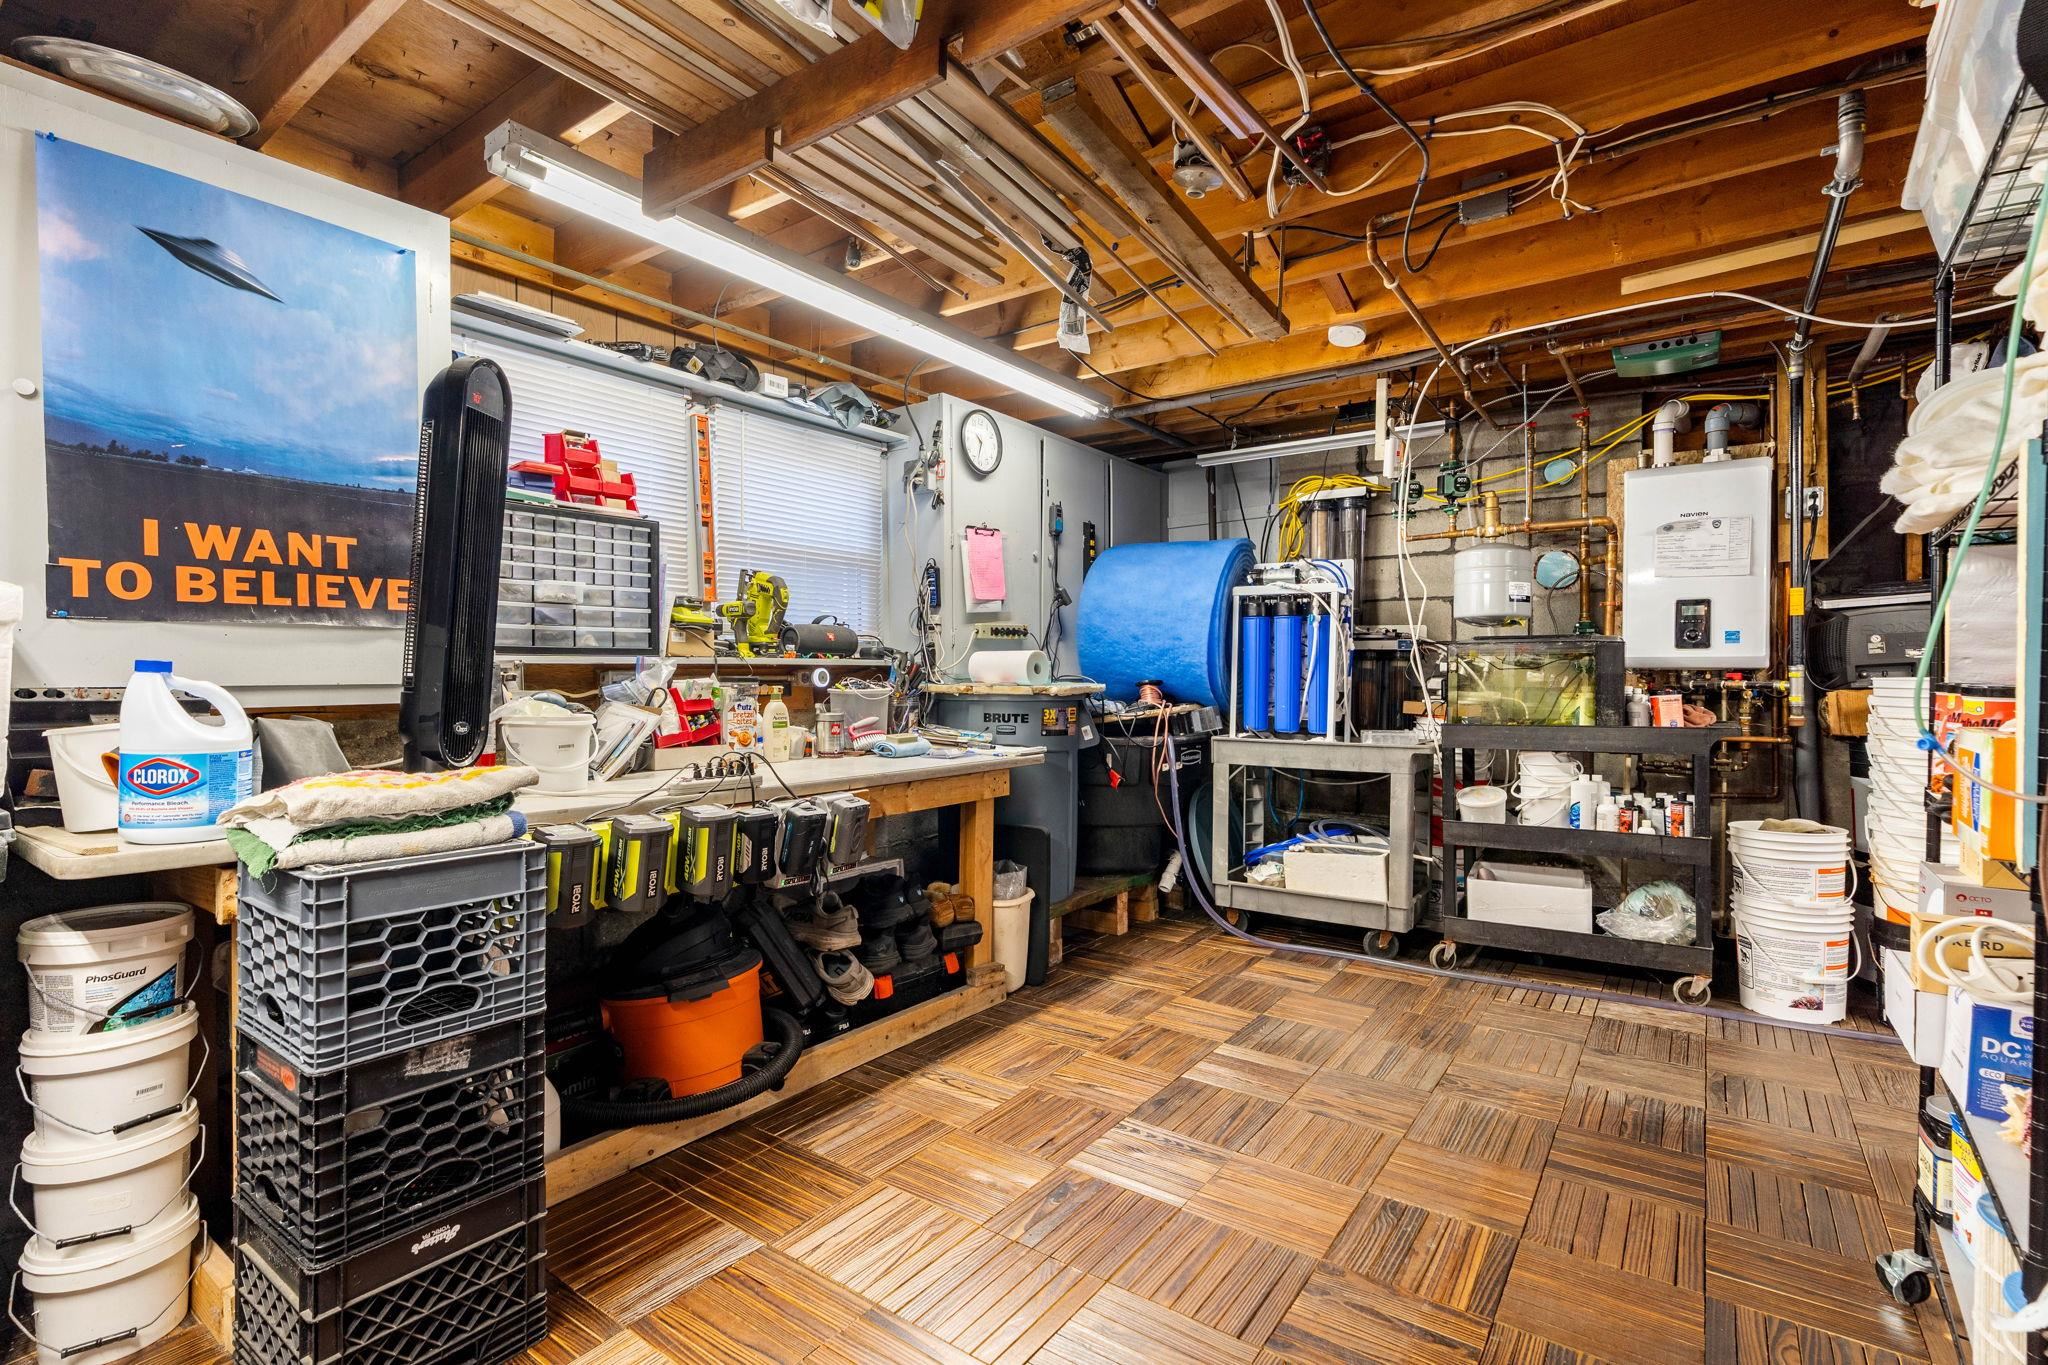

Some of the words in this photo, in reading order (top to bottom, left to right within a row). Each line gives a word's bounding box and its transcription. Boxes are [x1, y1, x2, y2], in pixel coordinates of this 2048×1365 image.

[143, 518, 159, 557] I
[184, 522, 358, 570] WANT
[58, 557, 153, 600] TO
[176, 565, 411, 612] BELIEVE
[983, 712, 1030, 724] BRUTE
[1043, 708, 1057, 720] 3X
[133, 768, 190, 785] CLOROX
[716, 856, 725, 882] RYOBI
[761, 847, 769, 872] RYOBI
[647, 870, 658, 898] RYOBI
[571, 884, 582, 914] RYOBI
[85, 966, 147, 984] PhosGuard
[1981, 1036, 2022, 1059] DC
[1980, 1053, 2033, 1068] AQUARI
[1984, 1070, 2001, 1080] ECO
